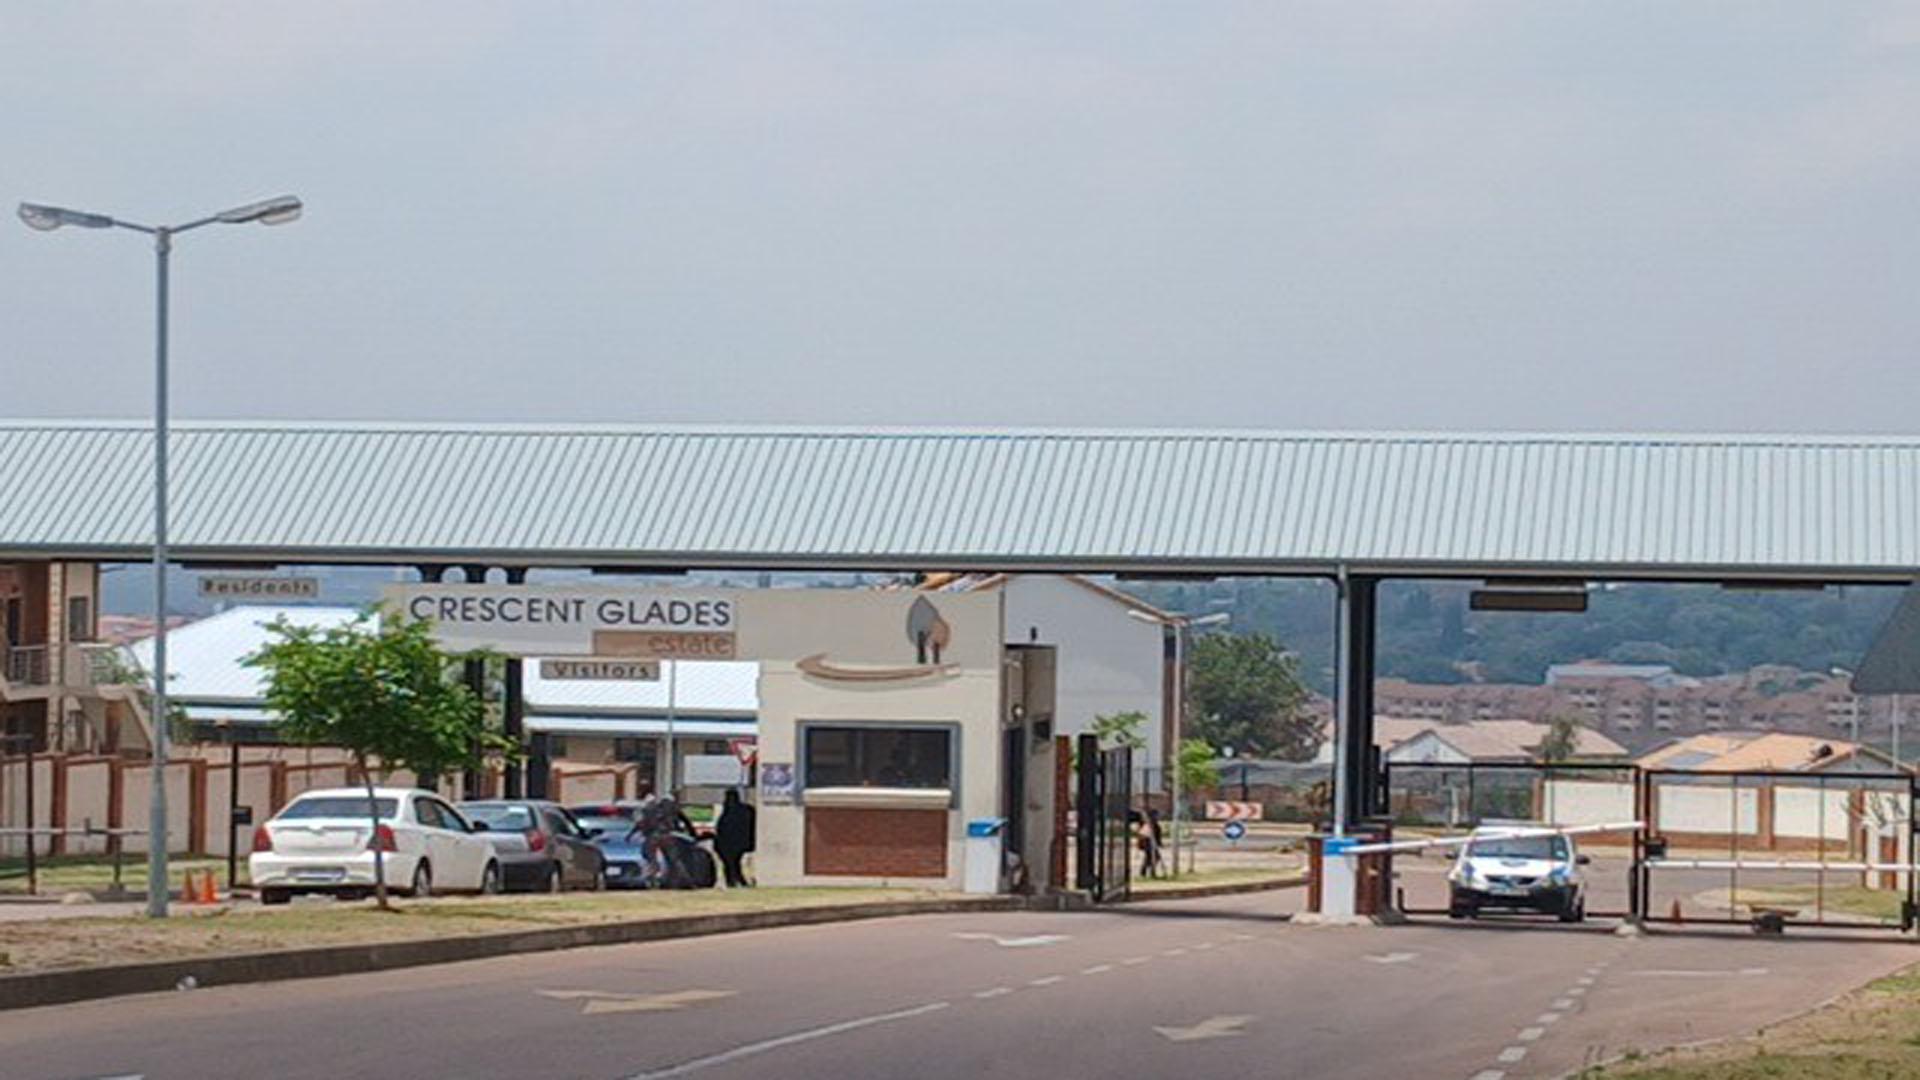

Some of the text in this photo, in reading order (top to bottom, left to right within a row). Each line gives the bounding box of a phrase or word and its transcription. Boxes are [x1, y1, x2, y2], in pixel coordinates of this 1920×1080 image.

[204, 579, 313, 594] Residents
[410, 595, 731, 627] CRESCENT GLADES
[647, 634, 730, 655] estate
[553, 661, 650, 679] Visitors
